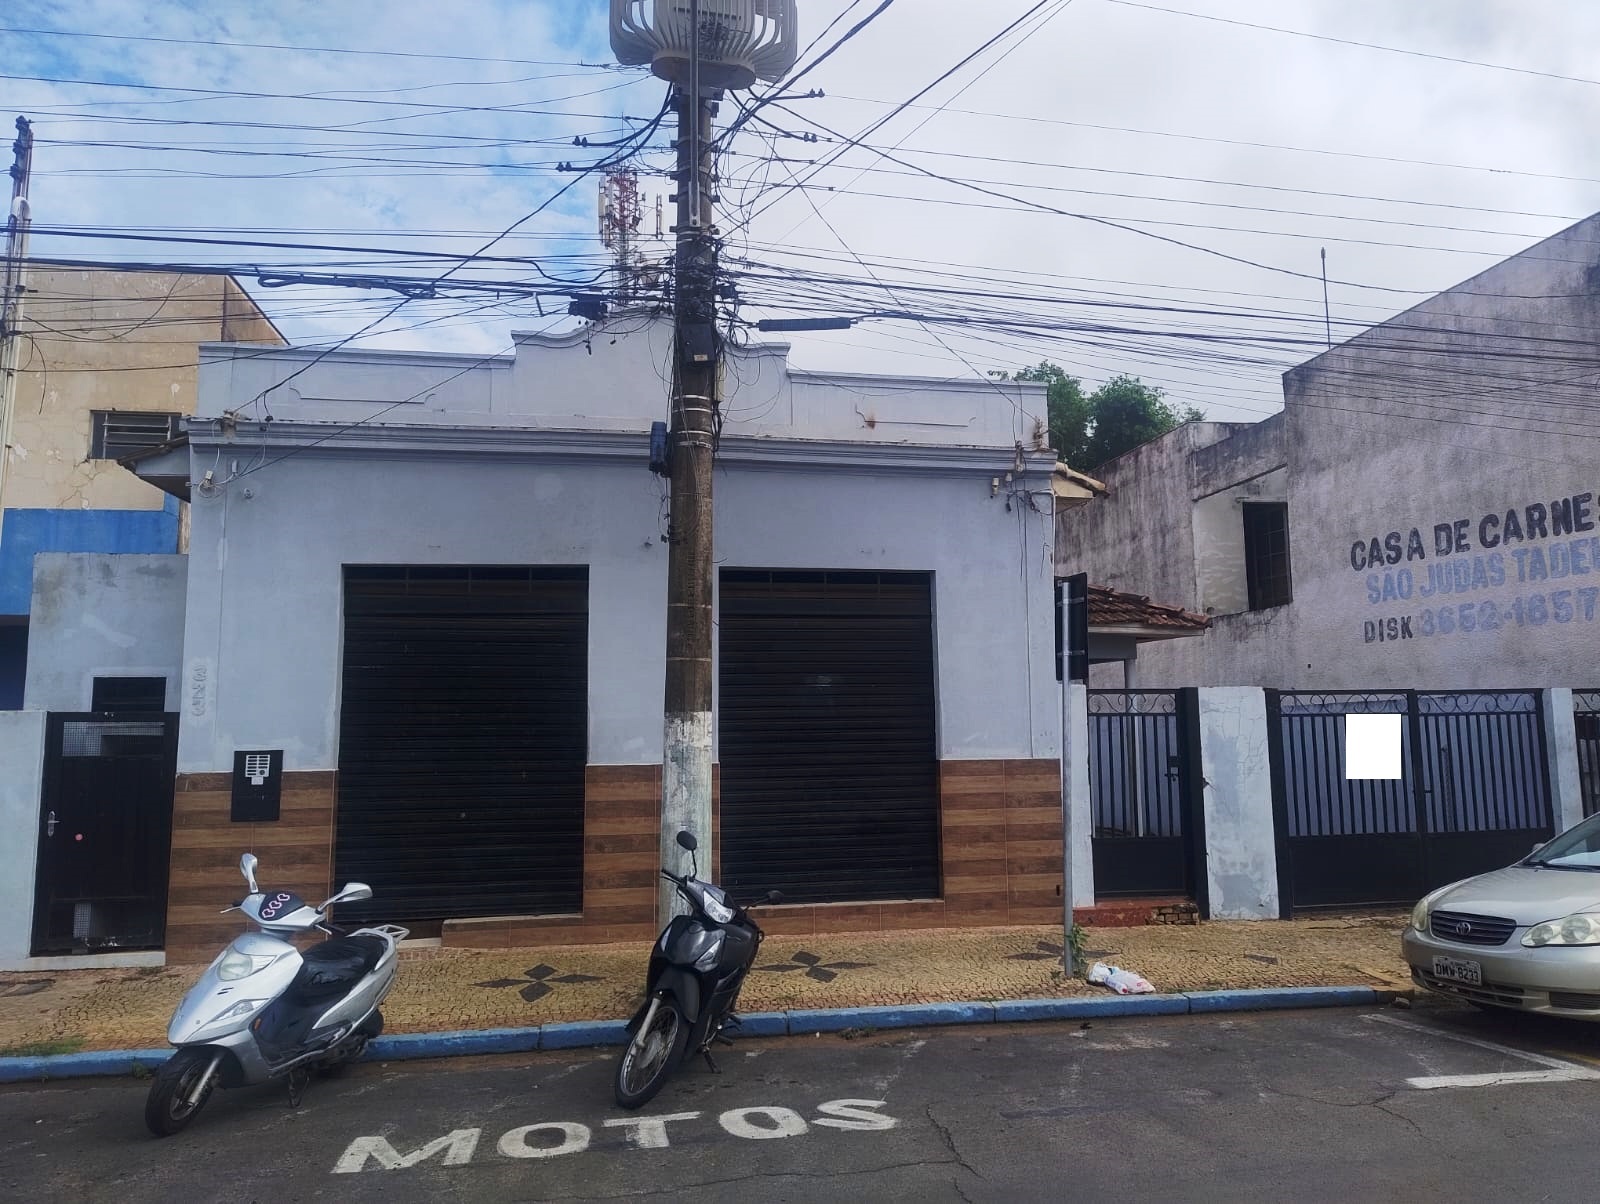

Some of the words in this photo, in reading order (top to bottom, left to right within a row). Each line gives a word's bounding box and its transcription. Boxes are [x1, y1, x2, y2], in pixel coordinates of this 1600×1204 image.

[1350, 527, 1425, 571] CASA
[1434, 519, 1470, 557] DE
[1479, 492, 1600, 548] CARNE
[1366, 566, 1414, 604] SÃO
[1420, 552, 1506, 597] JUDAS
[1364, 616, 1413, 643] DISK
[330, 1098, 897, 1174] MOTOS
